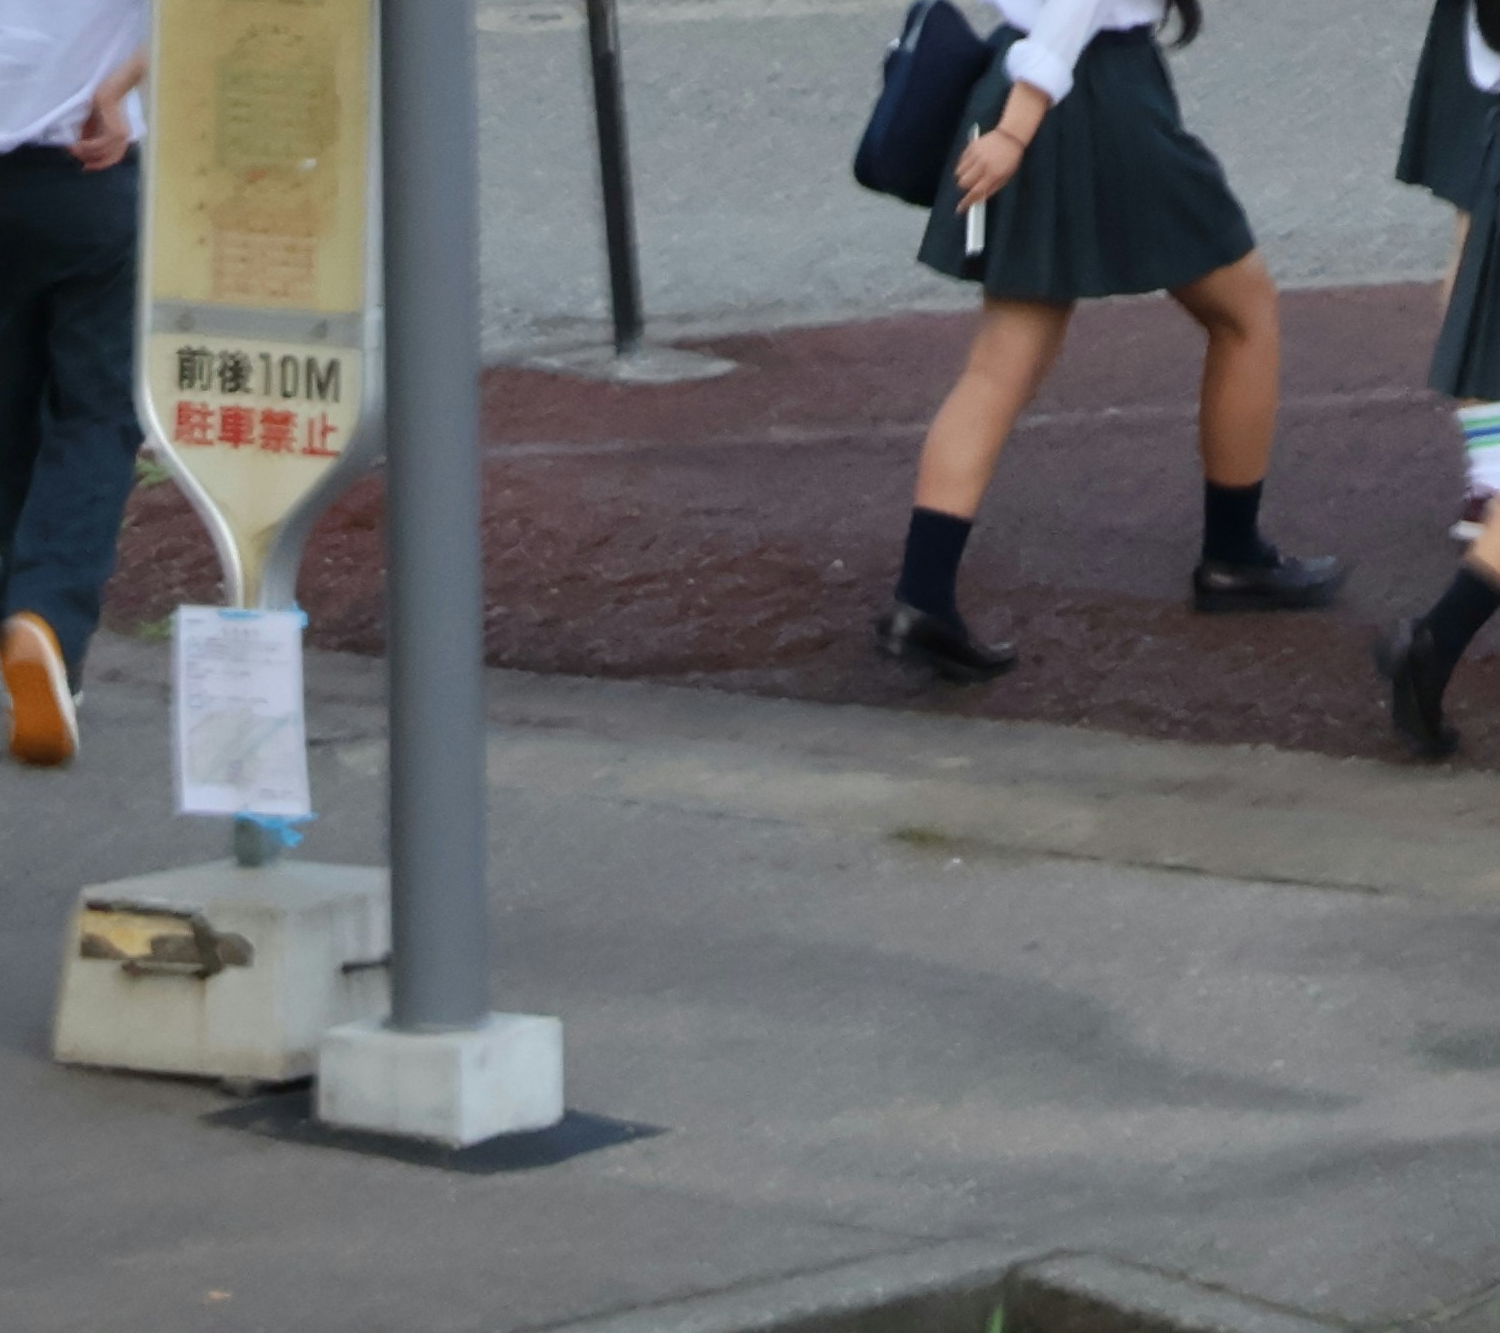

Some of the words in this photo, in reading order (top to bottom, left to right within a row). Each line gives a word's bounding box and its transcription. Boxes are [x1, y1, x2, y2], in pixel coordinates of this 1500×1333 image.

[176, 345, 343, 402] 前後10M
[173, 400, 343, 458] 駐車禁止
